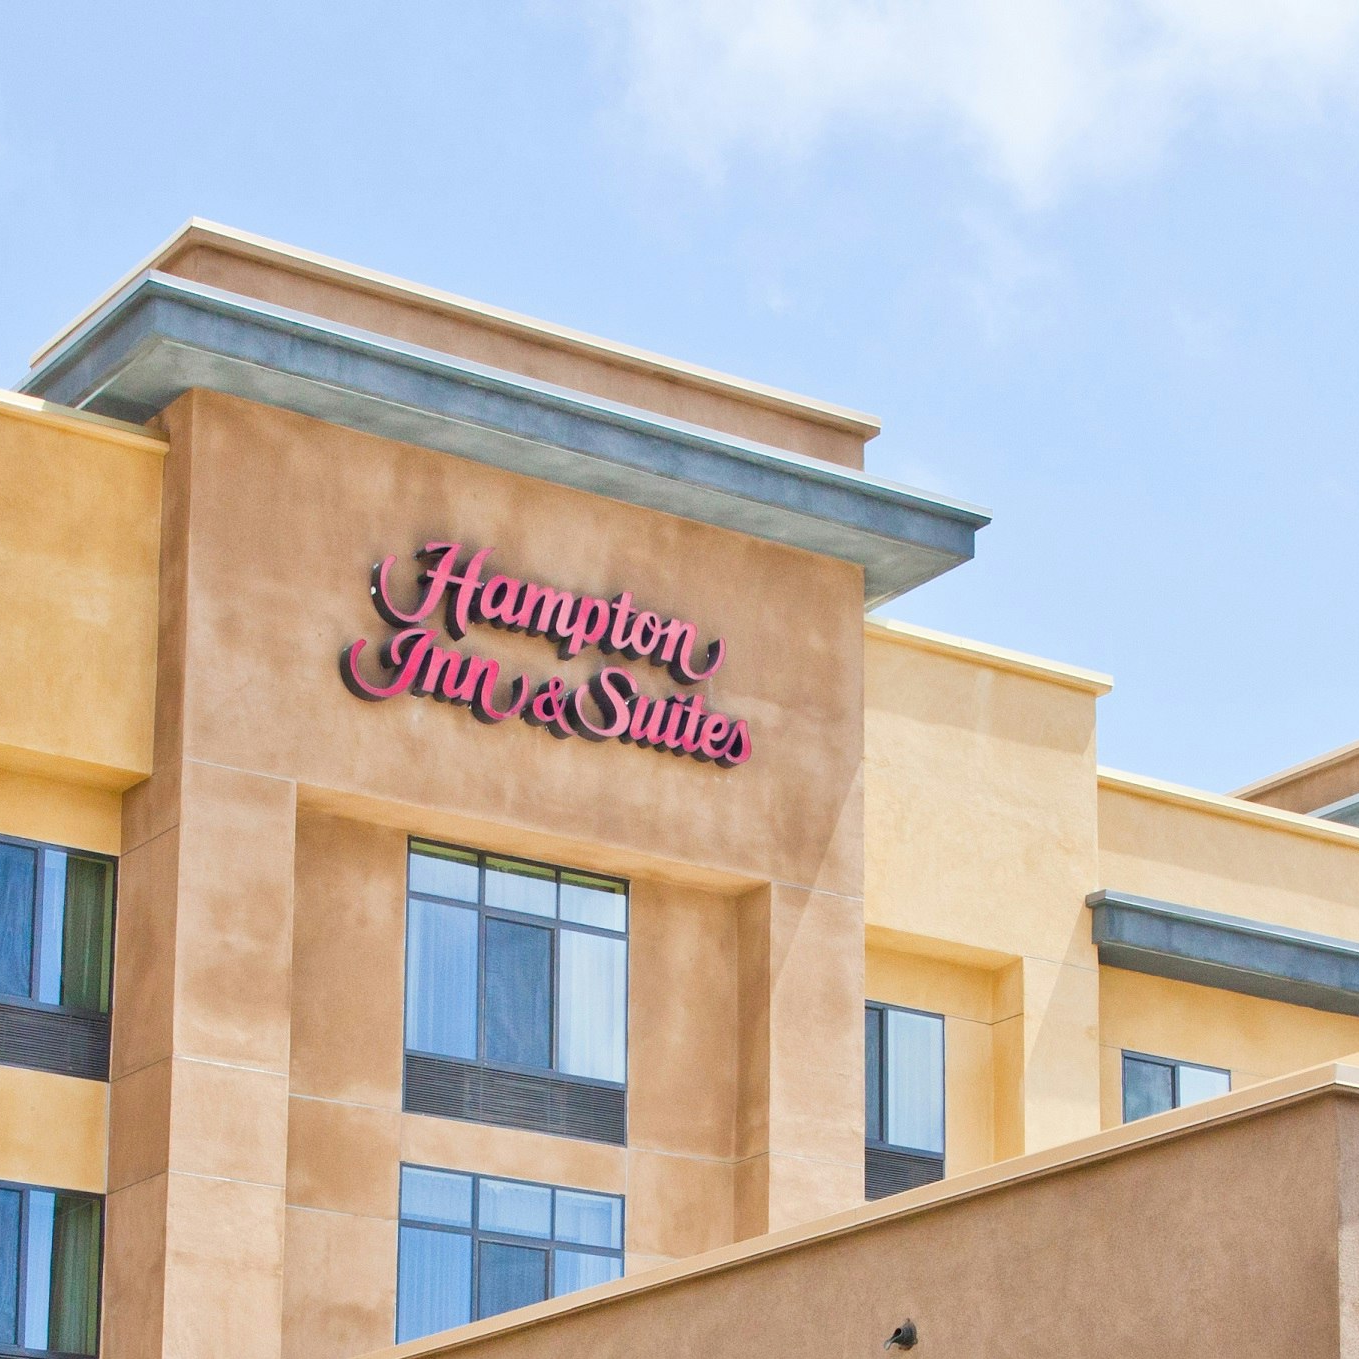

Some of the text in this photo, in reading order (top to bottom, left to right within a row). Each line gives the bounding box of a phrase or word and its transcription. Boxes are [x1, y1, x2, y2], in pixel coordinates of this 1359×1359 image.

[373, 542, 726, 684] Hampton
[344, 628, 752, 766] Inn & Suites
